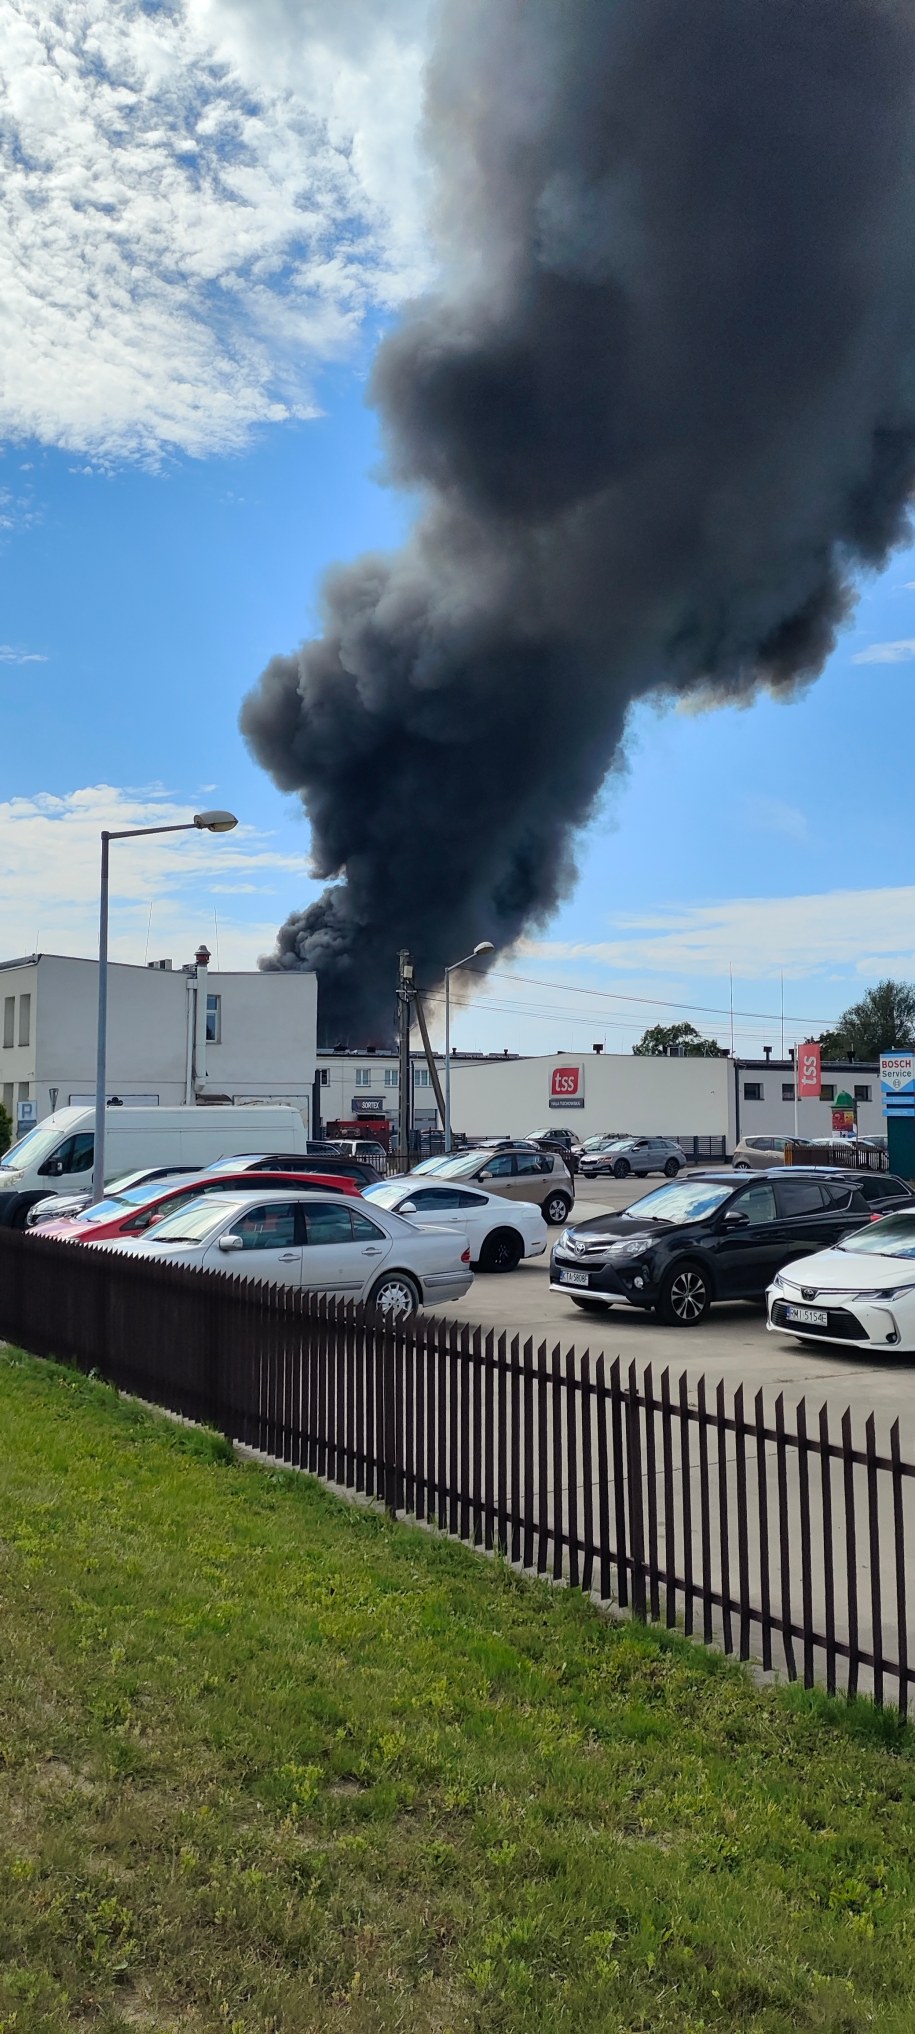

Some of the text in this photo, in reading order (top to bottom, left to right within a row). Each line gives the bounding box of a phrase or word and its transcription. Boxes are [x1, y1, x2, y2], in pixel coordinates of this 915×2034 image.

[881, 1059, 912, 1069] BOSCH
[801, 1055, 816, 1085] tss
[881, 1069, 912, 1078] Service
[555, 1072, 575, 1092] tss
[361, 1101, 381, 1109] SORTEX
